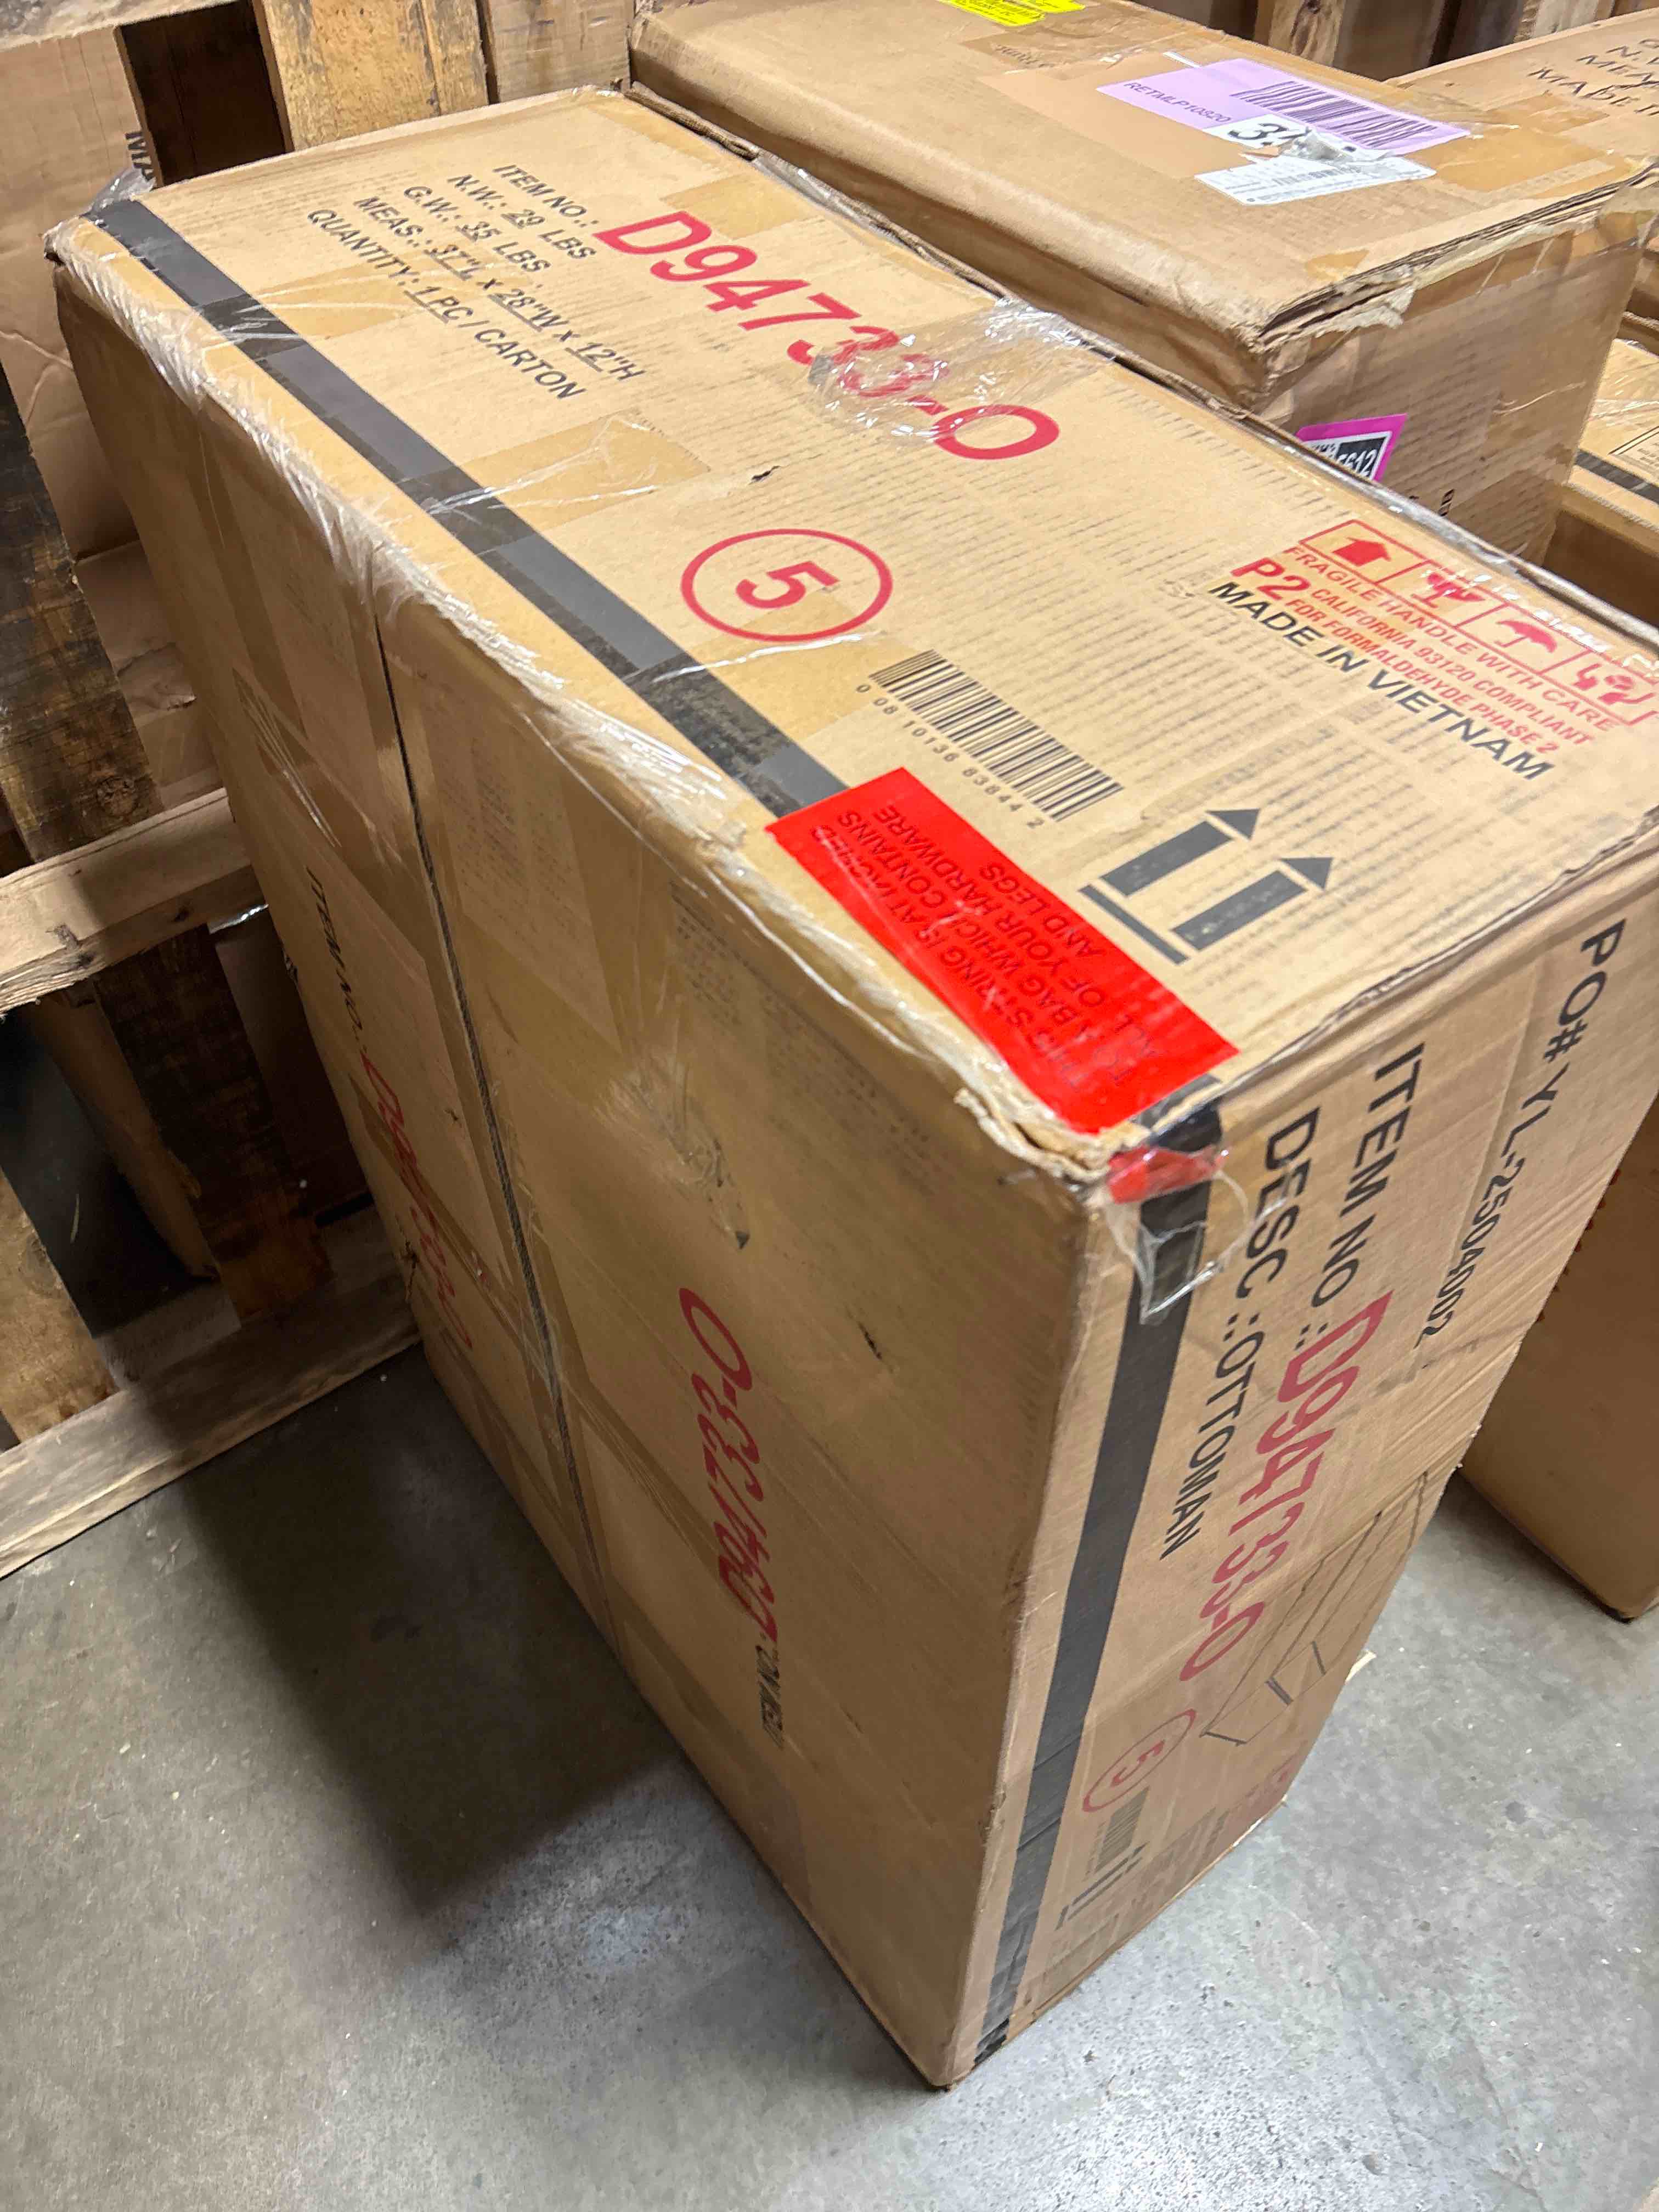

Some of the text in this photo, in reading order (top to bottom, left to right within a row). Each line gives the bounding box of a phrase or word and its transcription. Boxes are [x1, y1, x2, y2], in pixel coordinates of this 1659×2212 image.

[403, 185, 462, 222] G.W.:
[493, 241, 552, 272] LBS
[447, 174, 596, 259] N.W.: 29 LBS
[493, 165, 556, 196] ITEM
[307, 208, 420, 286] QUANTITY:
[426, 295, 473, 321] PC
[475, 328, 587, 399] CARTON
[353, 196, 433, 247] MEAS.:
[565, 342, 646, 381] 12"H
[735, 560, 840, 610] 5
[1230, 556, 1311, 603] P2
[1208, 582, 1556, 781] MADE IN VIETNAM
[1280, 546, 1626, 733] FRAGILE HANDLE WITH CARE
[1284, 597, 1562, 755] FOR FORMALDEHYDE PHASE 2
[1311, 587, 1596, 747] CALIFORNIA 93120 COMPLIANT
[837, 811, 949, 910] CONTAINS
[873, 805, 1003, 917] HARDWARE
[978, 860, 1103, 959] AND LEGS
[915, 926, 948, 948] IS
[938, 945, 1035, 1028] STRING
[943, 906, 1026, 977] WHICH
[994, 915, 1069, 975] YOUR
[1015, 977, 1079, 1025] BAG
[1061, 973, 1106, 1007] OF
[1031, 1028, 1092, 1089] THIS
[1339, 1042, 1425, 1217] ITEM
[1414, 917, 1627, 1349] PO# YL-2504002
[1159, 1330, 1264, 1561] OTTOMAN
[1179, 1289, 1394, 1681] D94733-0
